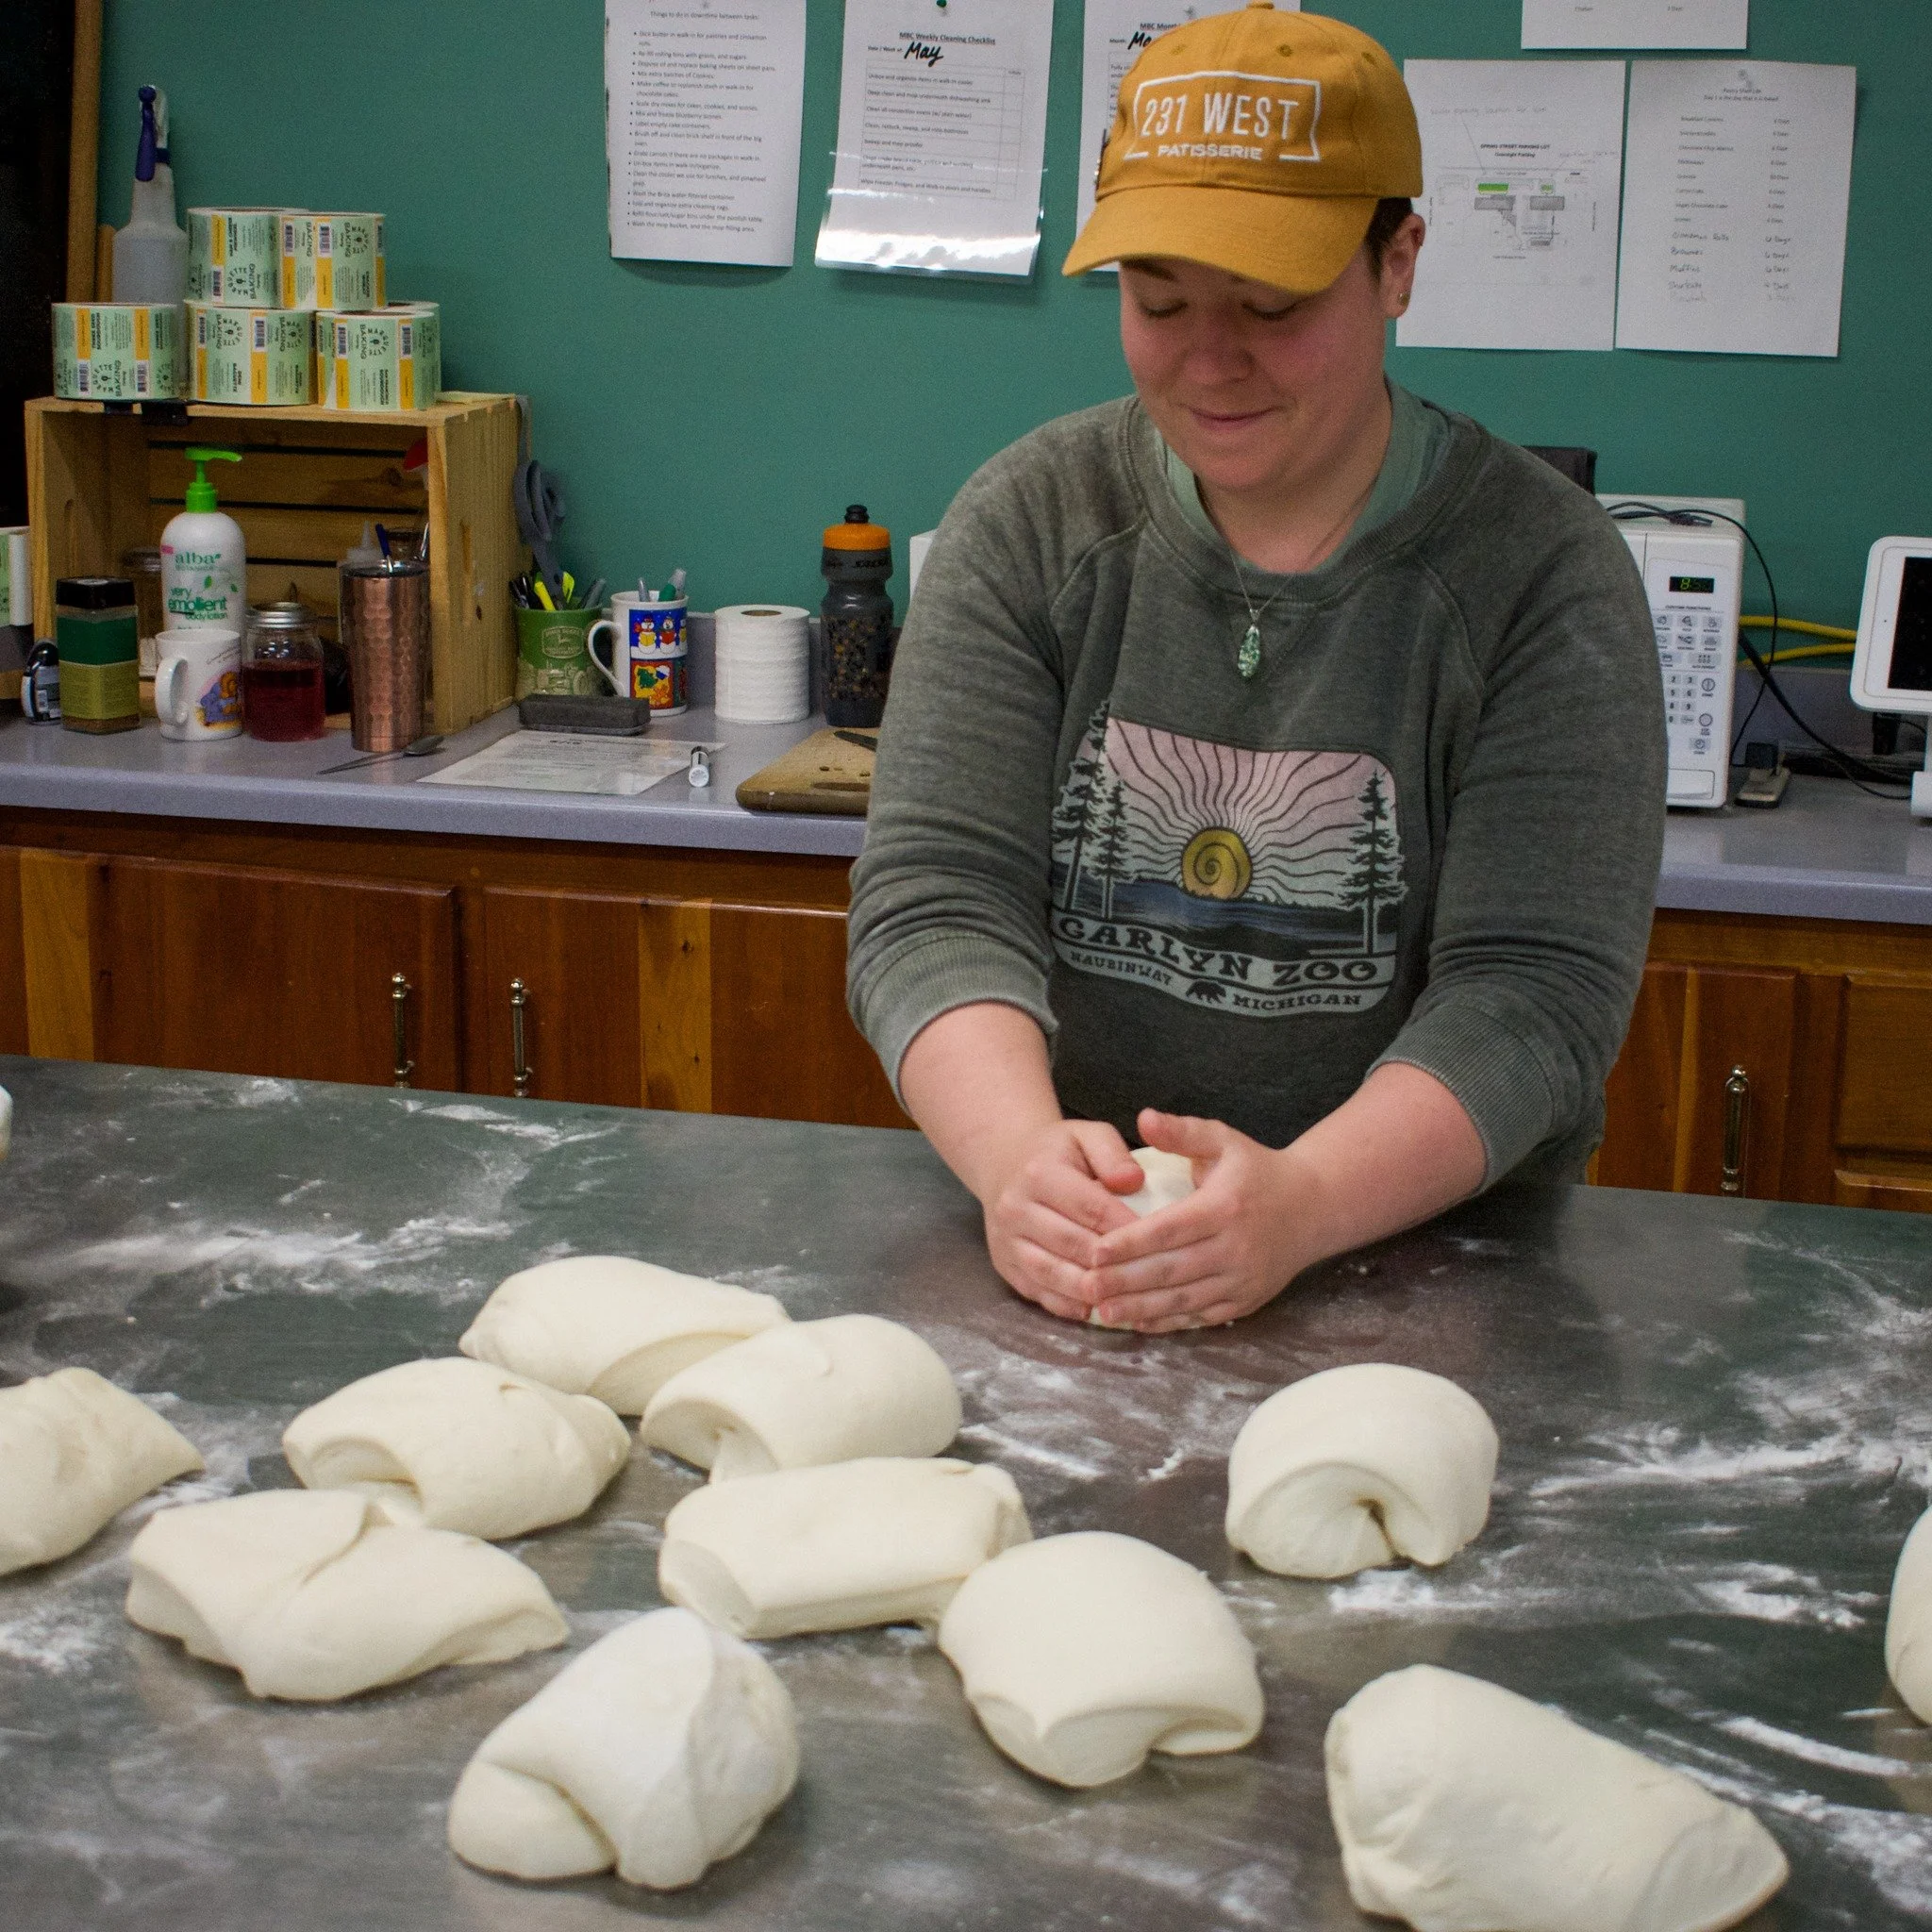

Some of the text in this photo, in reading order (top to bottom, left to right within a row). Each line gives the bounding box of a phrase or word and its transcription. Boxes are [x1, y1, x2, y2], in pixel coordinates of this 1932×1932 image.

[915, 34, 939, 42] Weekly
[941, 36, 967, 44] Cleaning
[968, 37, 996, 45] Checklist
[903, 41, 944, 68] May
[1140, 92, 1299, 141] 231 WEST
[1158, 143, 1263, 161] PATISSERIE
[175, 551, 215, 565] alba
[170, 586, 192, 600] very
[167, 595, 228, 611] emollient
[1058, 914, 1378, 987] GARLYN ZOO
[1069, 949, 1363, 1011] NAUBINWAY MICHIGAN
